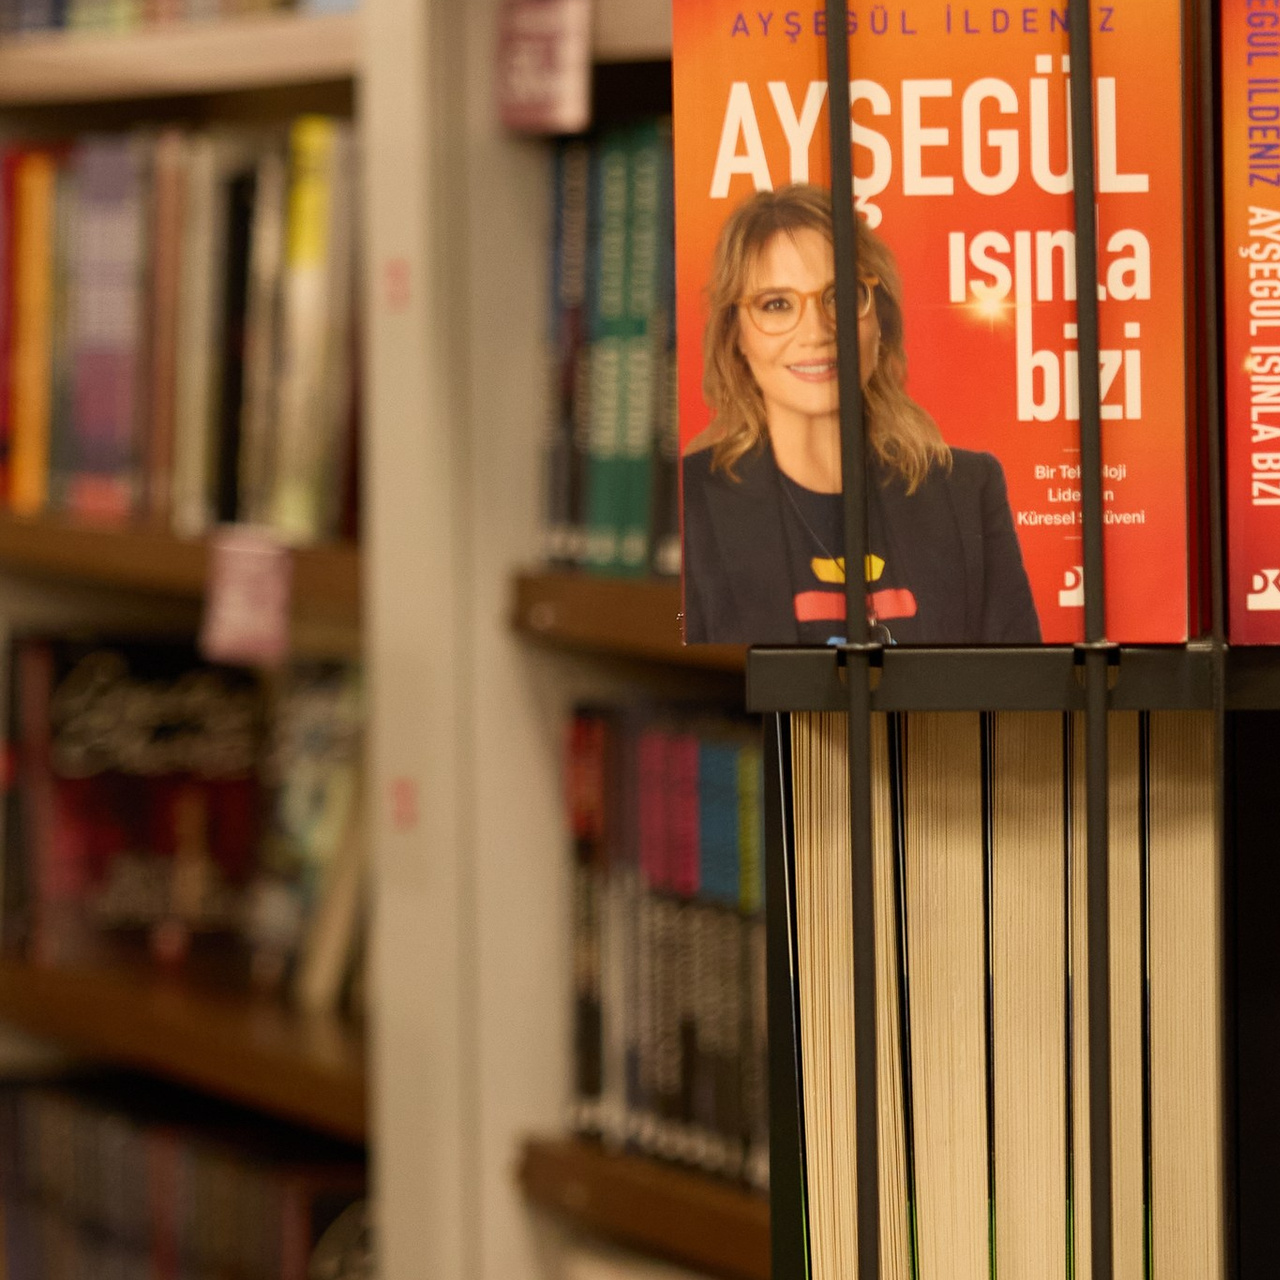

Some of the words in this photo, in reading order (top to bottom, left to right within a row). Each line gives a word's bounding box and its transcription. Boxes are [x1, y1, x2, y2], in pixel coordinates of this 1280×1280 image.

[945, 4, 1115, 34] İLDENZ
[710, 54, 1150, 230] AYŞEGÜL
[1034, 464, 1056, 480] Bir
[1017, 510, 1076, 526] Küresel
